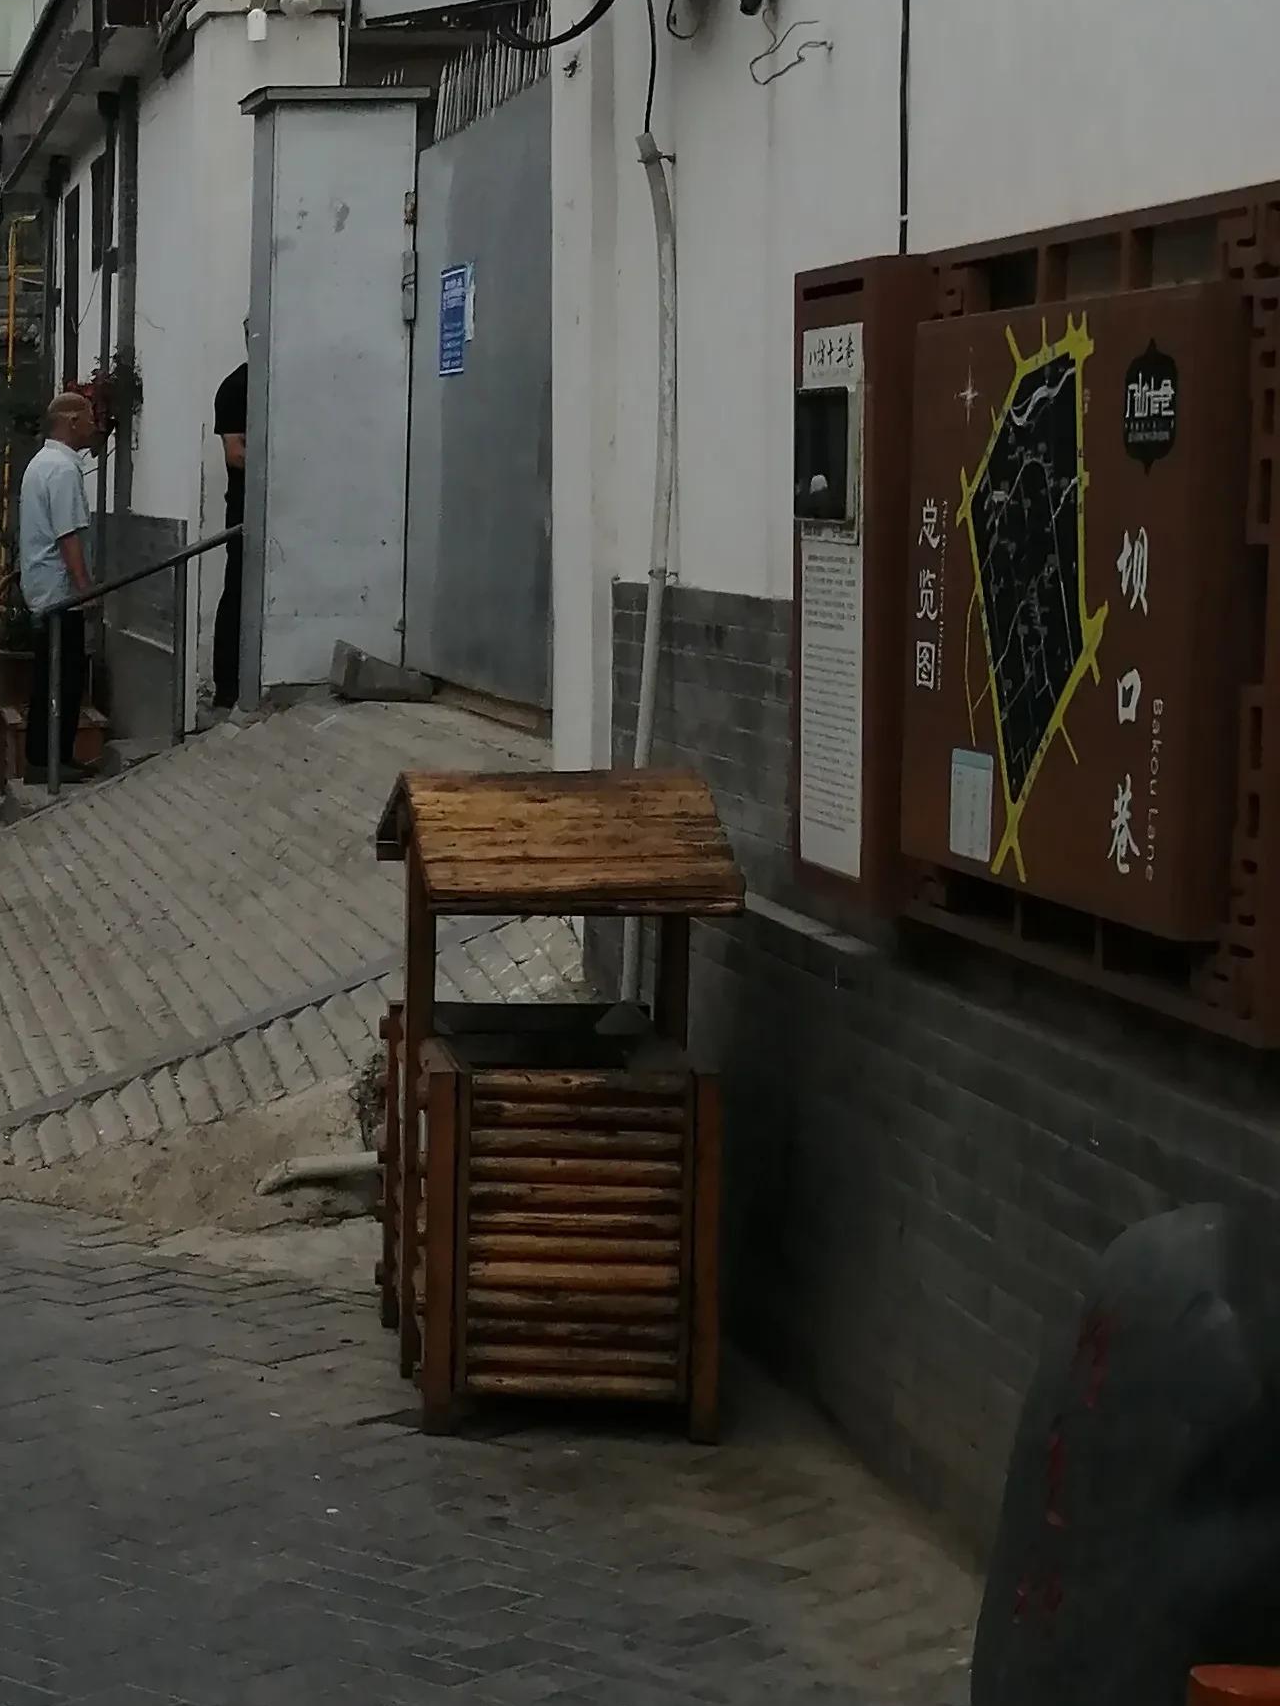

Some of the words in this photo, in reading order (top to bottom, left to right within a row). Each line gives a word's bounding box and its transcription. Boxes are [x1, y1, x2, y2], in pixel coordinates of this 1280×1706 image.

[915, 497, 940, 690] 总览图
[1107, 526, 1149, 874] 坝口巷
[1149, 698, 1164, 796] Bakou
[1145, 808, 1160, 882] Lane
